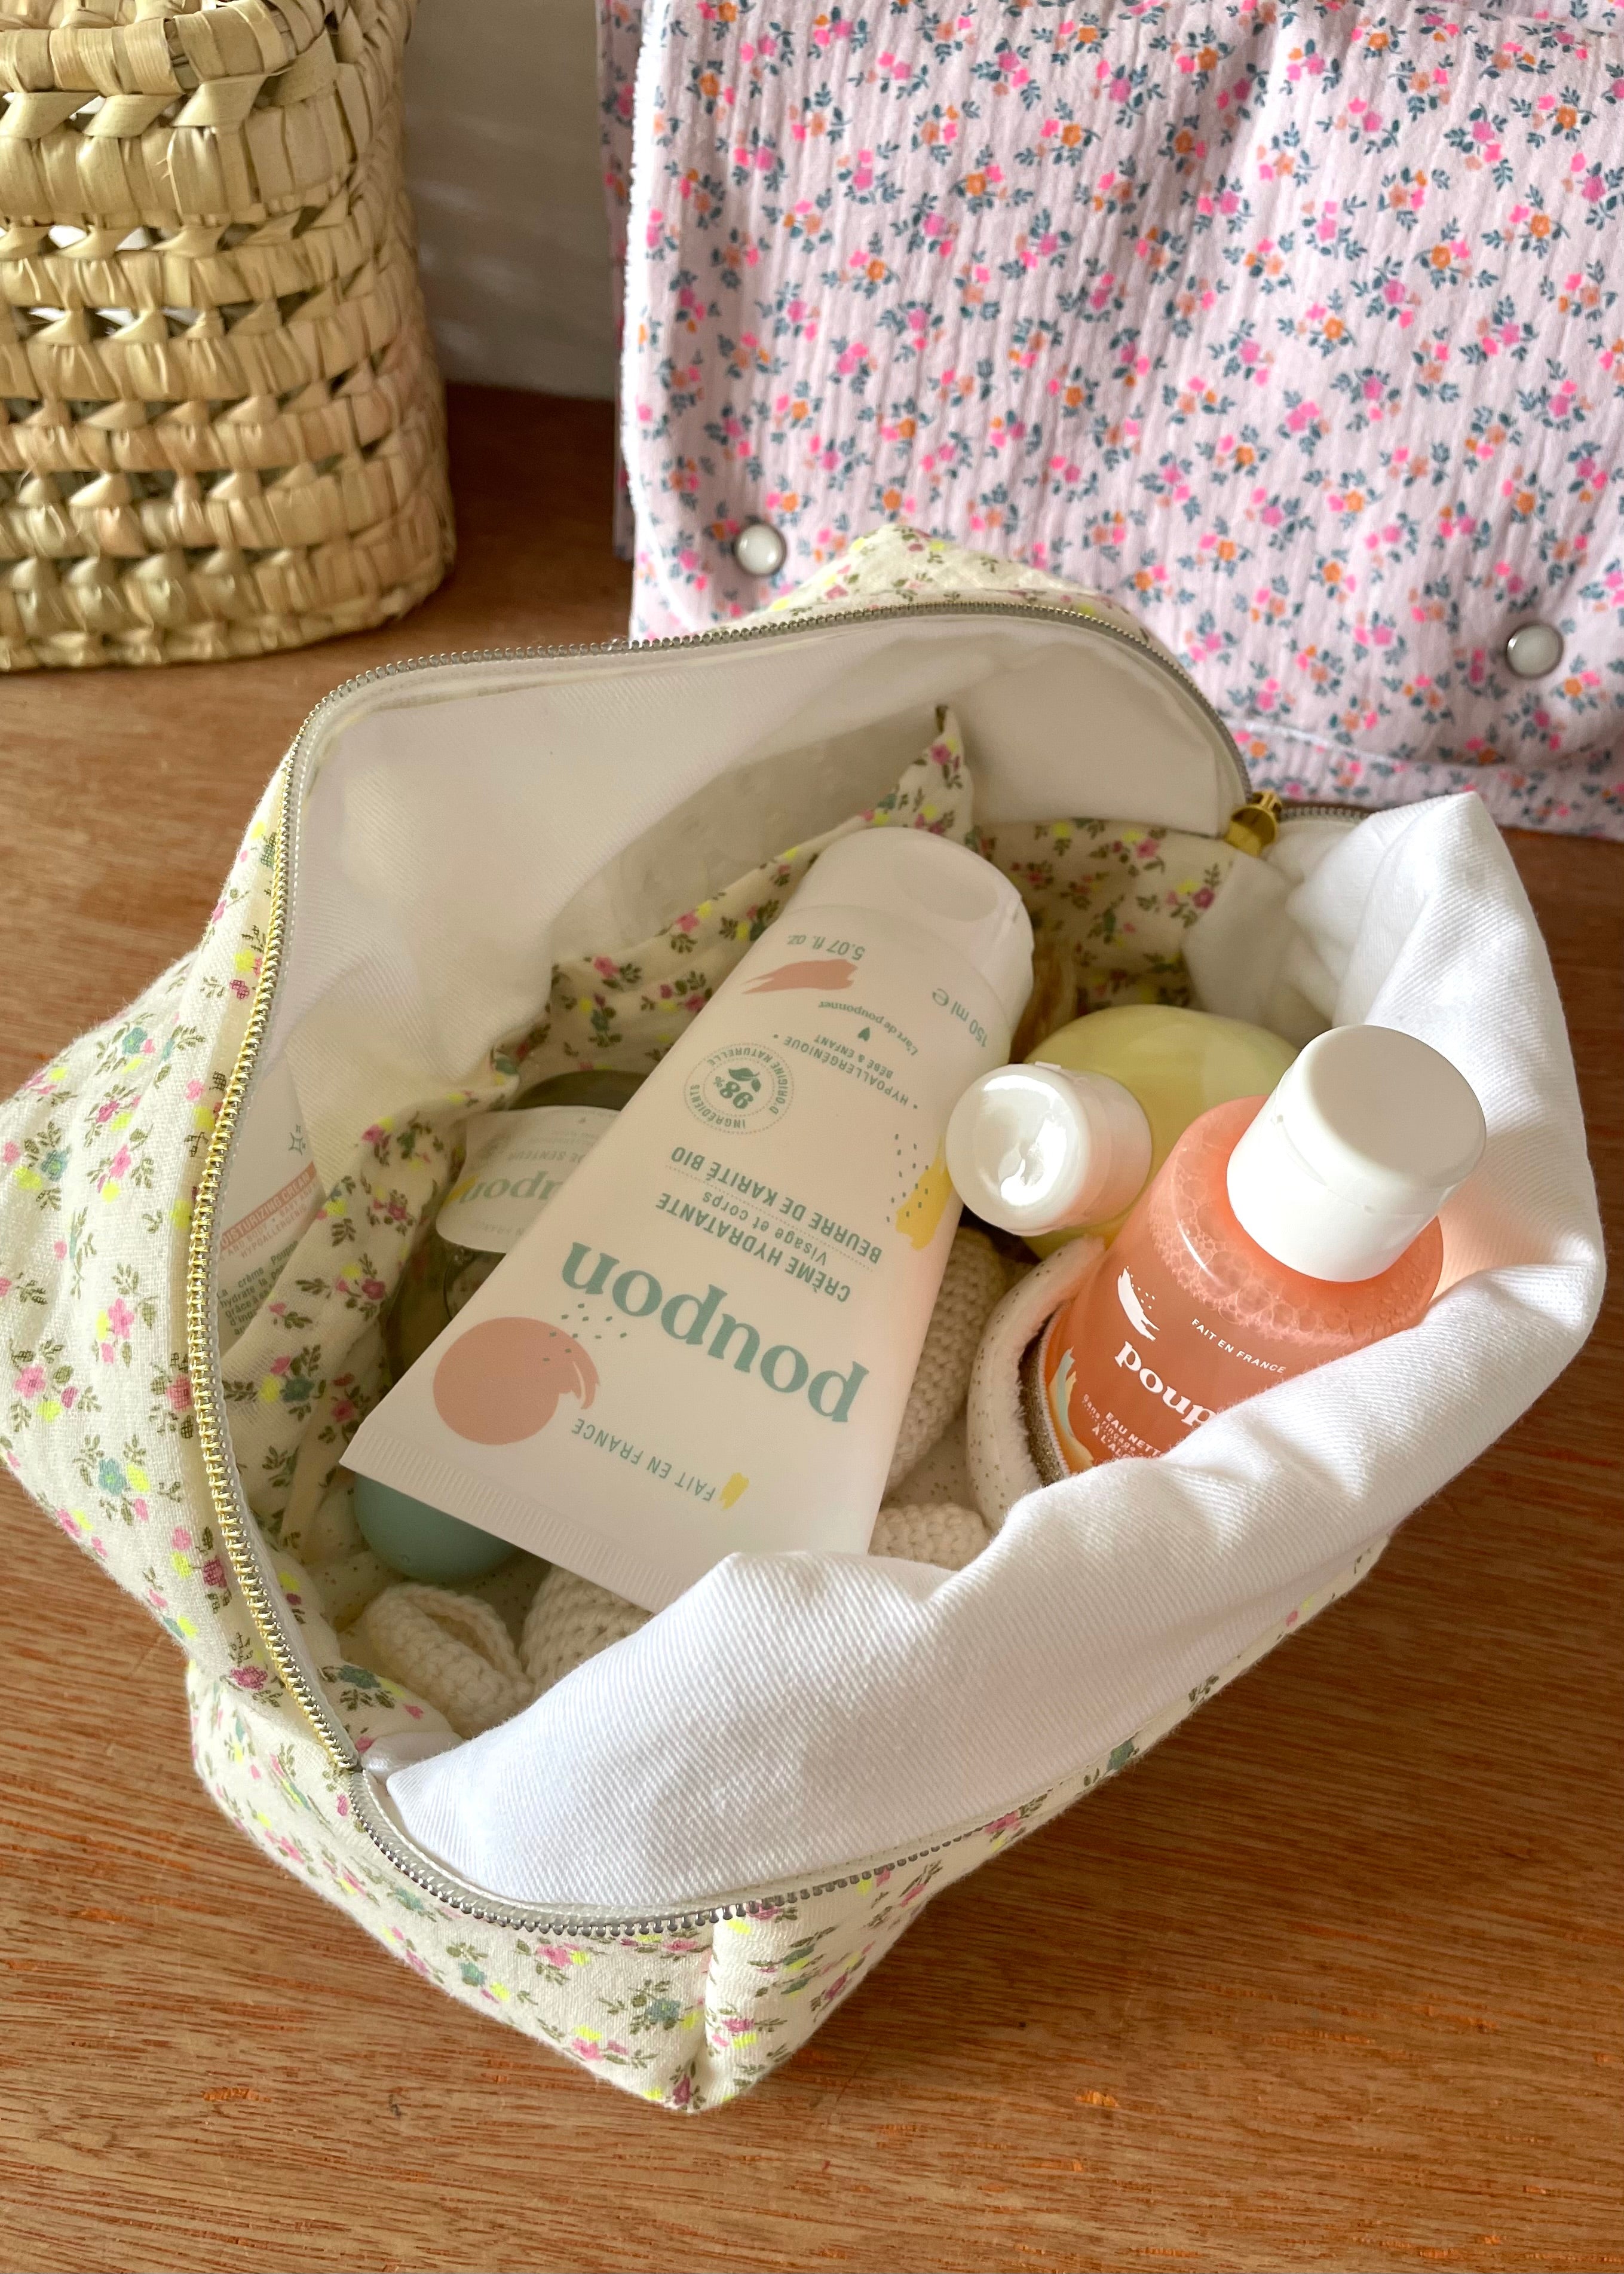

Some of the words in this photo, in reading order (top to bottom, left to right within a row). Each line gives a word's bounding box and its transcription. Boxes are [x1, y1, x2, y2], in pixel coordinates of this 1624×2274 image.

[826, 939, 865, 960] 5.07
[818, 1000, 885, 1029] pouponner
[950, 1000, 969, 1023] ml
[884, 1020, 897, 1034] de
[969, 1021, 989, 1048] 150
[707, 1047, 773, 1066] NATURELLE
[813, 1033, 855, 1059] ENFANT
[855, 1052, 866, 1063] &
[897, 1032, 918, 1057] L'art
[783, 1036, 909, 1106] HYPOALLERGÉNIQUE
[866, 1058, 894, 1079] BÉBÉ
[690, 1084, 746, 1128] INGRÉDIENTS
[713, 1076, 754, 1109] 98%
[671, 1146, 706, 1171] BIO
[705, 1161, 779, 1207] KARITÉ
[220, 1195, 282, 1247] OISTURIZING
[702, 1191, 749, 1221] corps
[779, 1196, 807, 1222] DE
[655, 1193, 783, 1266] HYDRATANTE
[752, 1213, 770, 1231] et
[774, 1226, 828, 1266] Visage
[808, 1212, 883, 1265] BEURRE
[785, 1255, 851, 1303] CRÈME
[562, 1241, 869, 1423] poupon
[1191, 1318, 1217, 1340] FAIT
[1217, 1339, 1235, 1354] EN
[1236, 1350, 1287, 1375] FRANCE
[1114, 1340, 1218, 1427] poup
[571, 1418, 644, 1464] FRANCE
[1105, 1412, 1128, 1435] EAU
[1128, 1433, 1165, 1458] NETT
[646, 1455, 673, 1479] EN
[674, 1471, 716, 1502] FAIT
